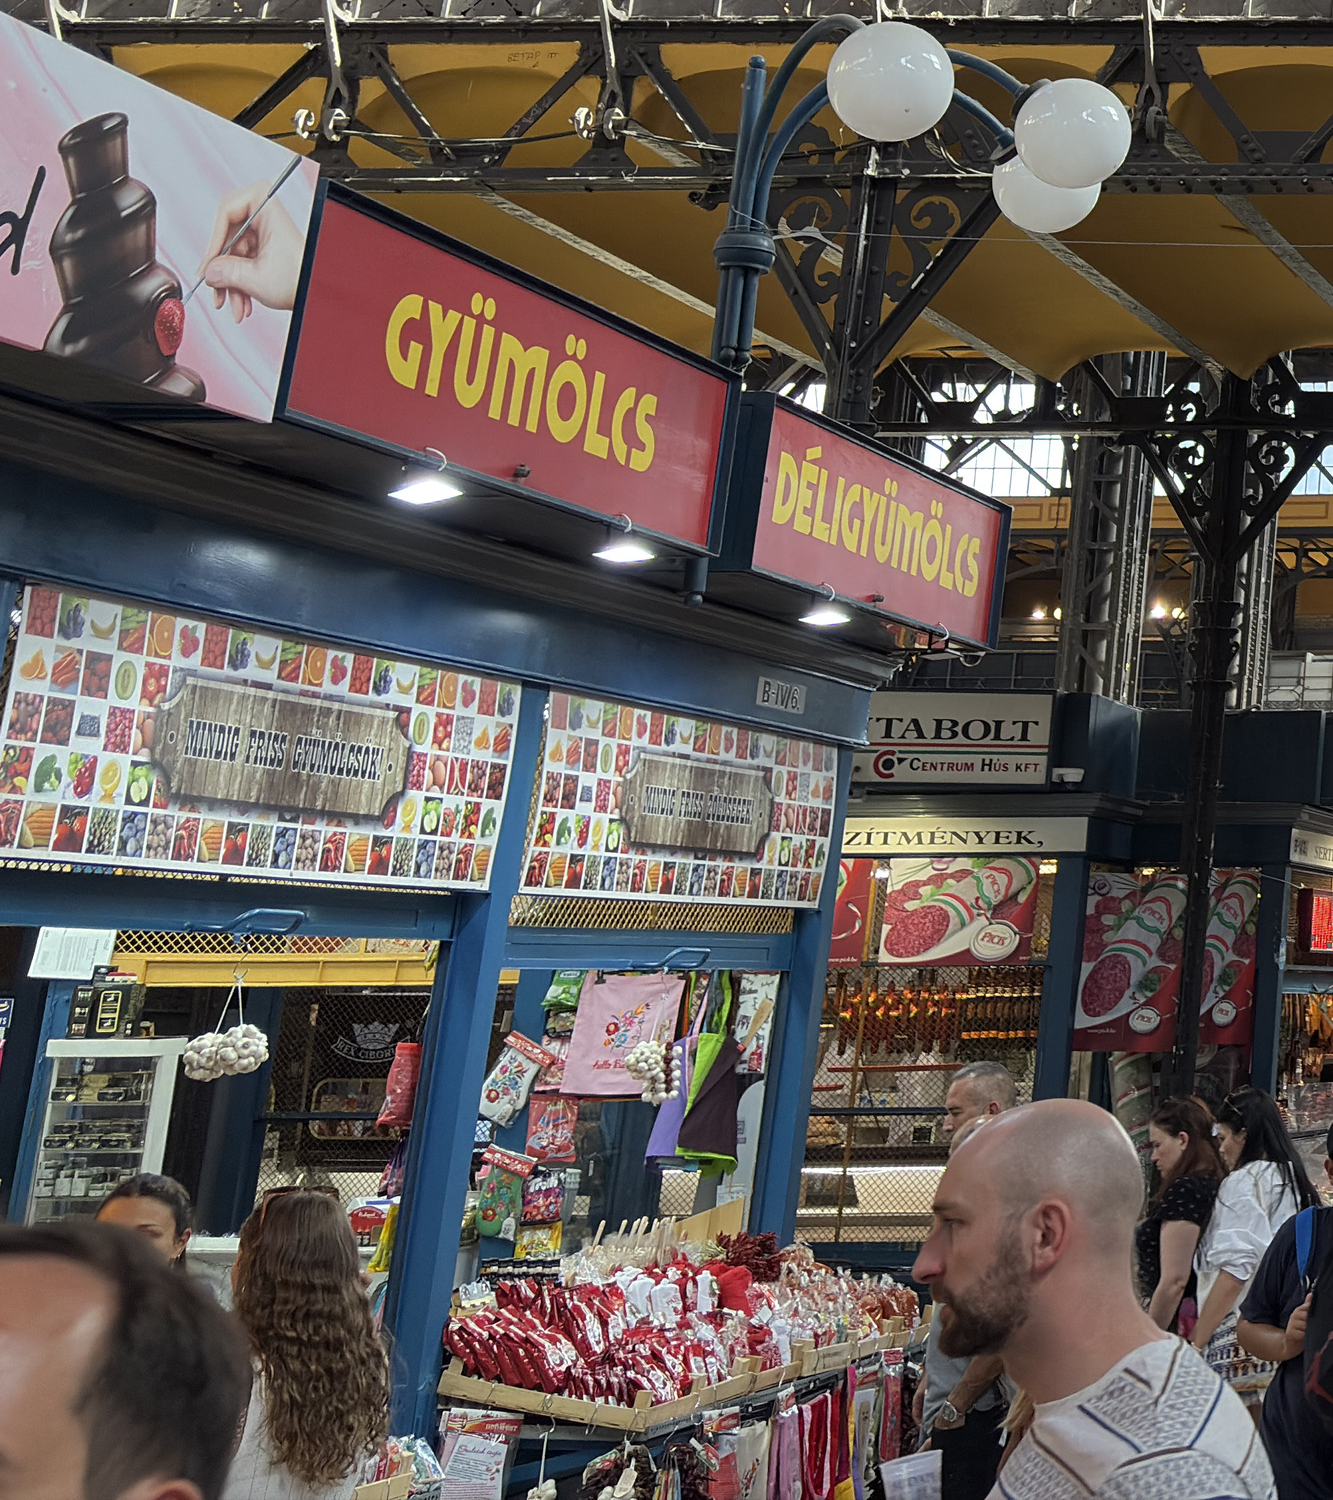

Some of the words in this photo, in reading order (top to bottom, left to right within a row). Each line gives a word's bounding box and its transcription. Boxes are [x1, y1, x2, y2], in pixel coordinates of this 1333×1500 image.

[385, 291, 659, 473] GYÜMÖLCS
[772, 445, 981, 599] DÉLIGYÜMÖLCS
[869, 717, 1040, 742] TABOLT
[184, 718, 241, 763] MINDIG
[244, 727, 288, 771] FRISS
[291, 730, 384, 783] GYÜMÖLCSÖK!
[642, 784, 677, 818] MINDIG
[679, 788, 704, 822] FRISS
[985, 873, 1002, 899] PICK
[1141, 906, 1166, 925] PICK
[980, 931, 1008, 946] PICK
